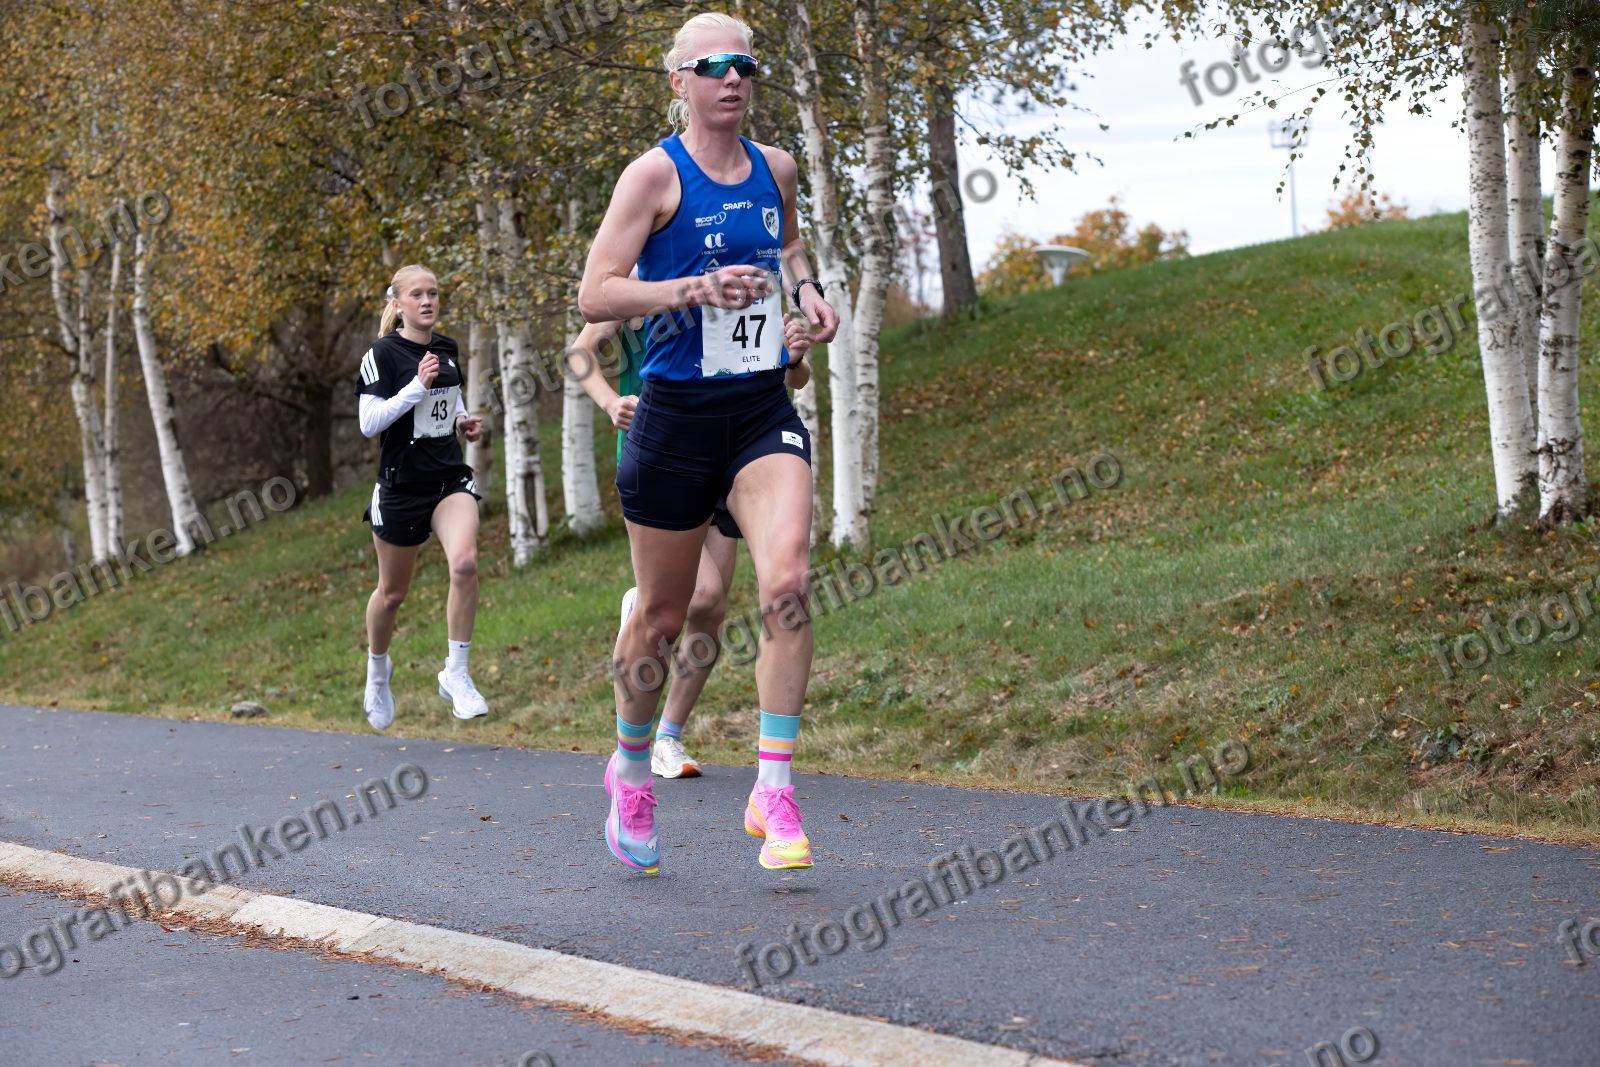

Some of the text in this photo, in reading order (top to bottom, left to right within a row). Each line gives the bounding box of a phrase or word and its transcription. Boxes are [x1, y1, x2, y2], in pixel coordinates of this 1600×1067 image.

[723, 202, 747, 210] CRAFT
[732, 314, 767, 349] 47
[742, 355, 761, 363] ELITE
[431, 400, 448, 421] 43
